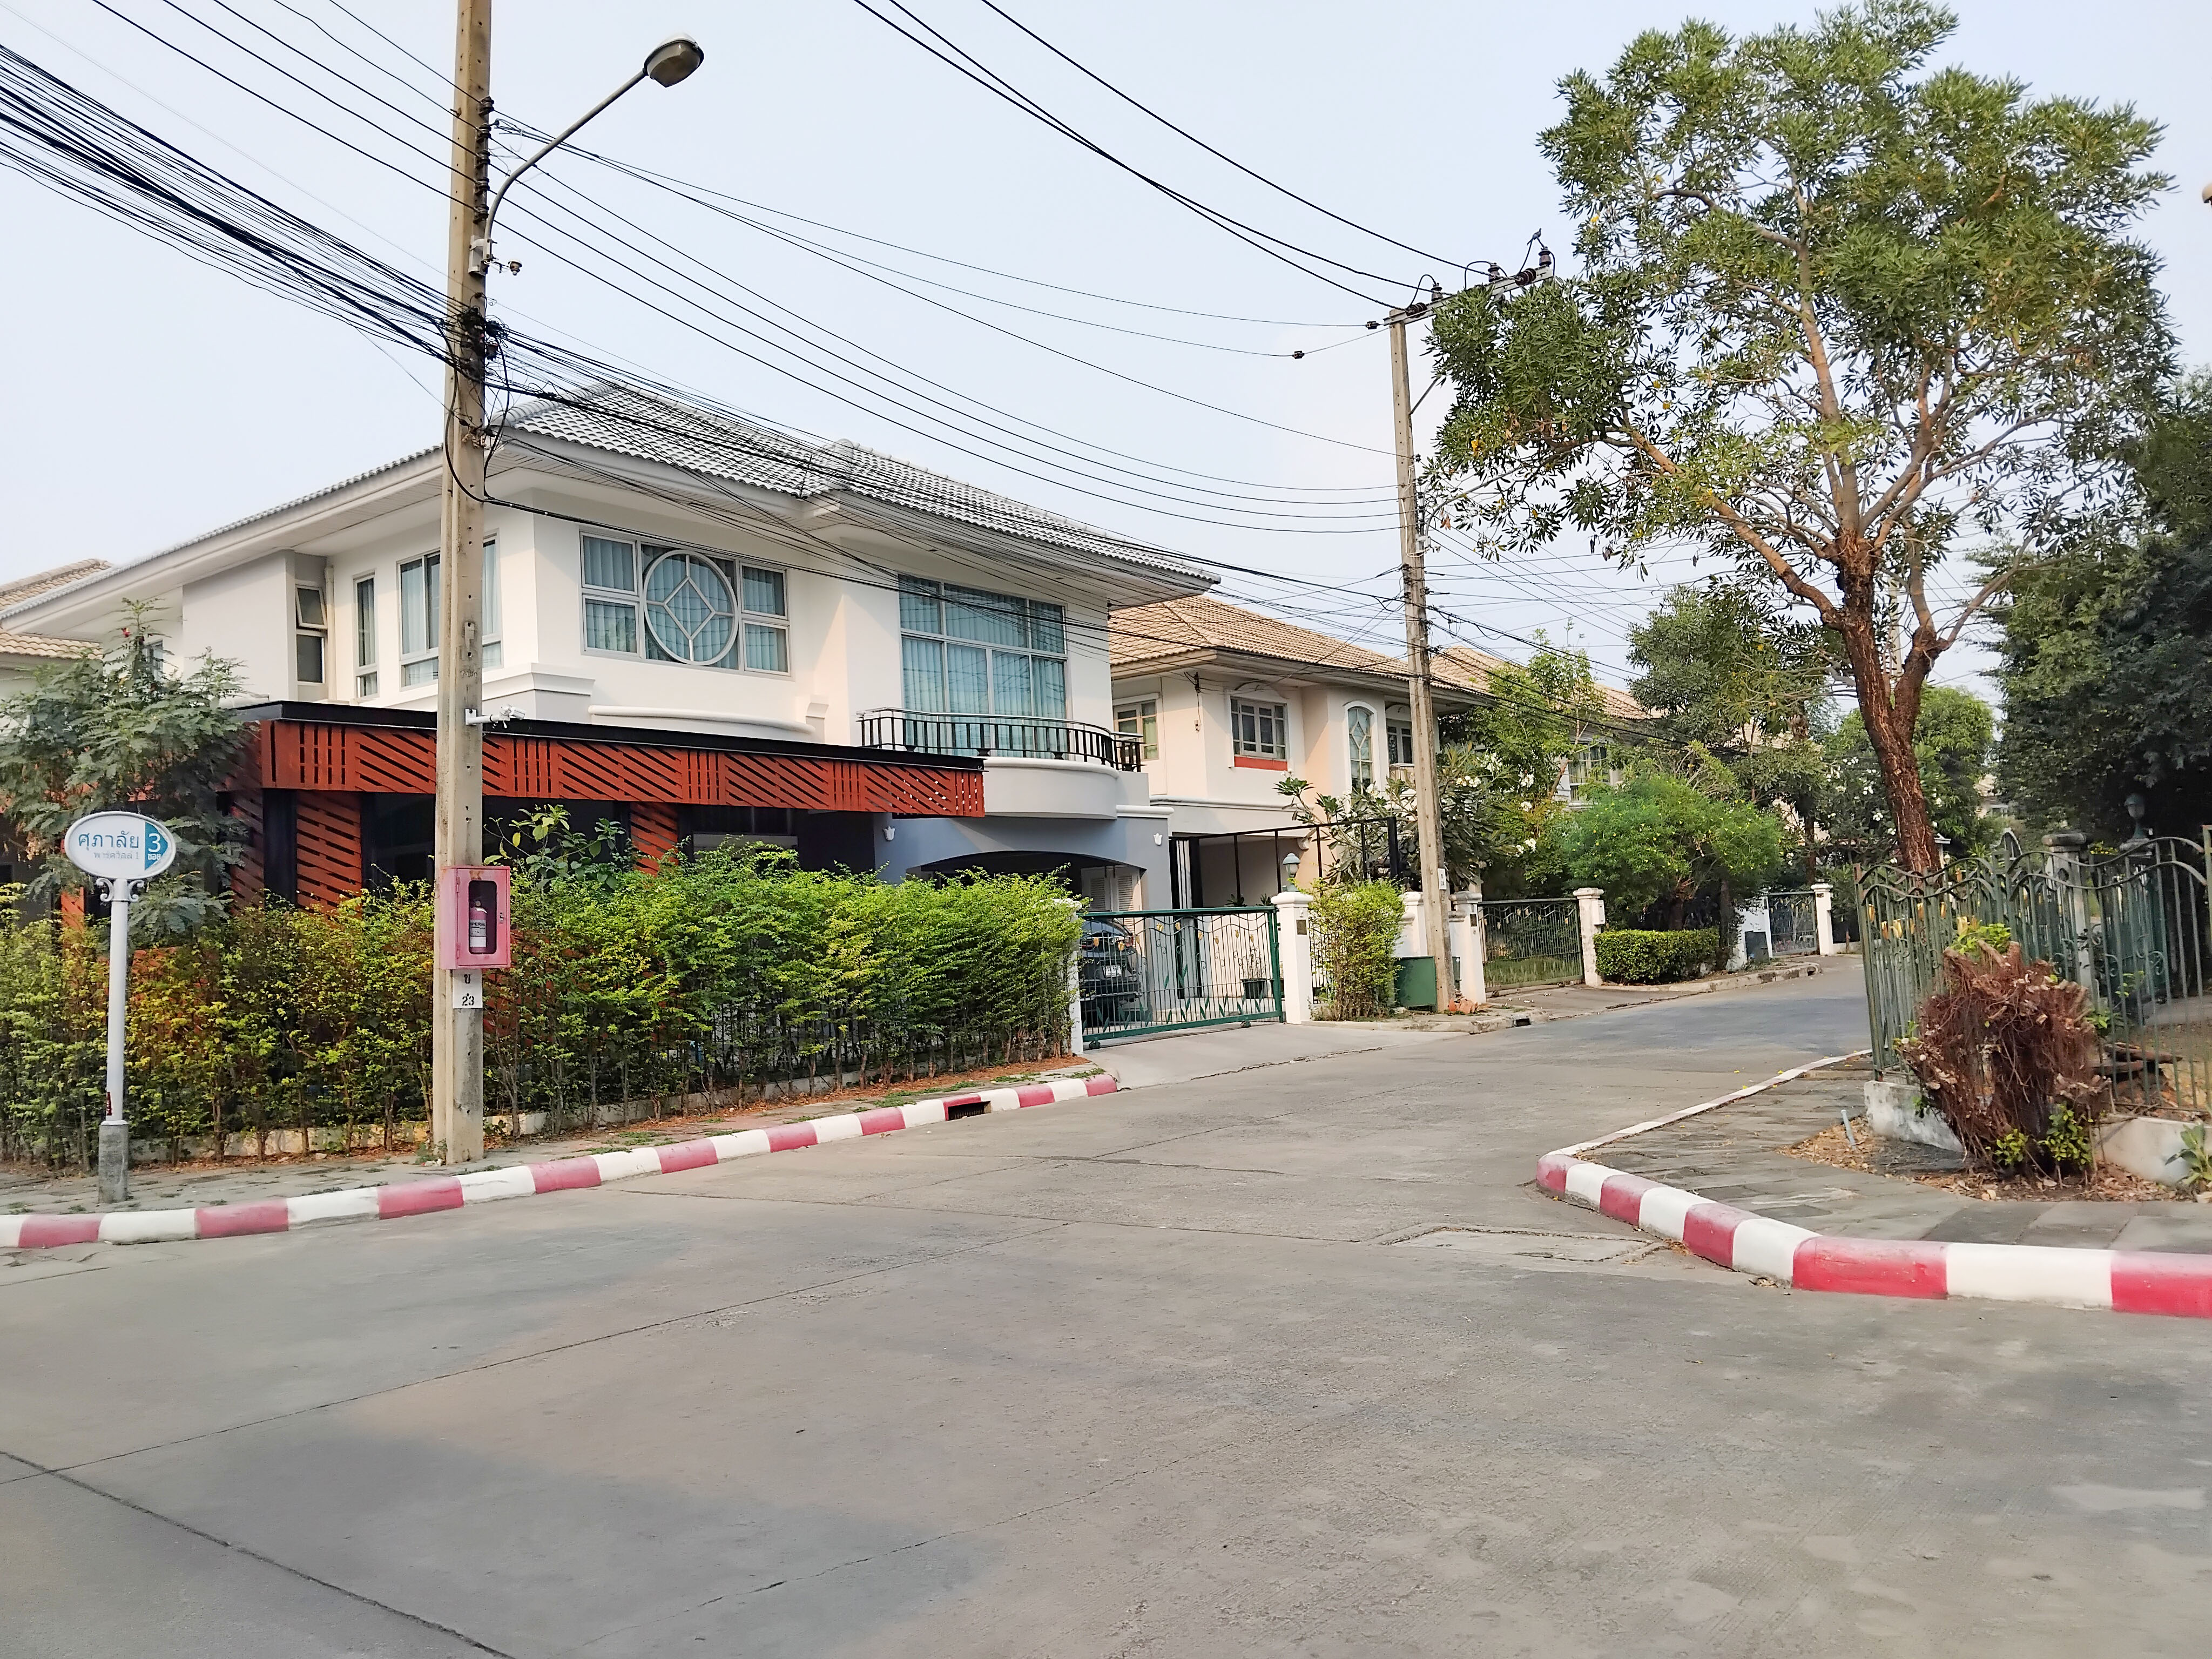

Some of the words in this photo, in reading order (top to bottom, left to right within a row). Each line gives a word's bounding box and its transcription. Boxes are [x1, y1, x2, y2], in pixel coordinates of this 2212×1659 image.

[78, 831, 139, 851] ศุภาลัย
[148, 833, 161, 853] 3
[462, 996, 474, 1006] 23
